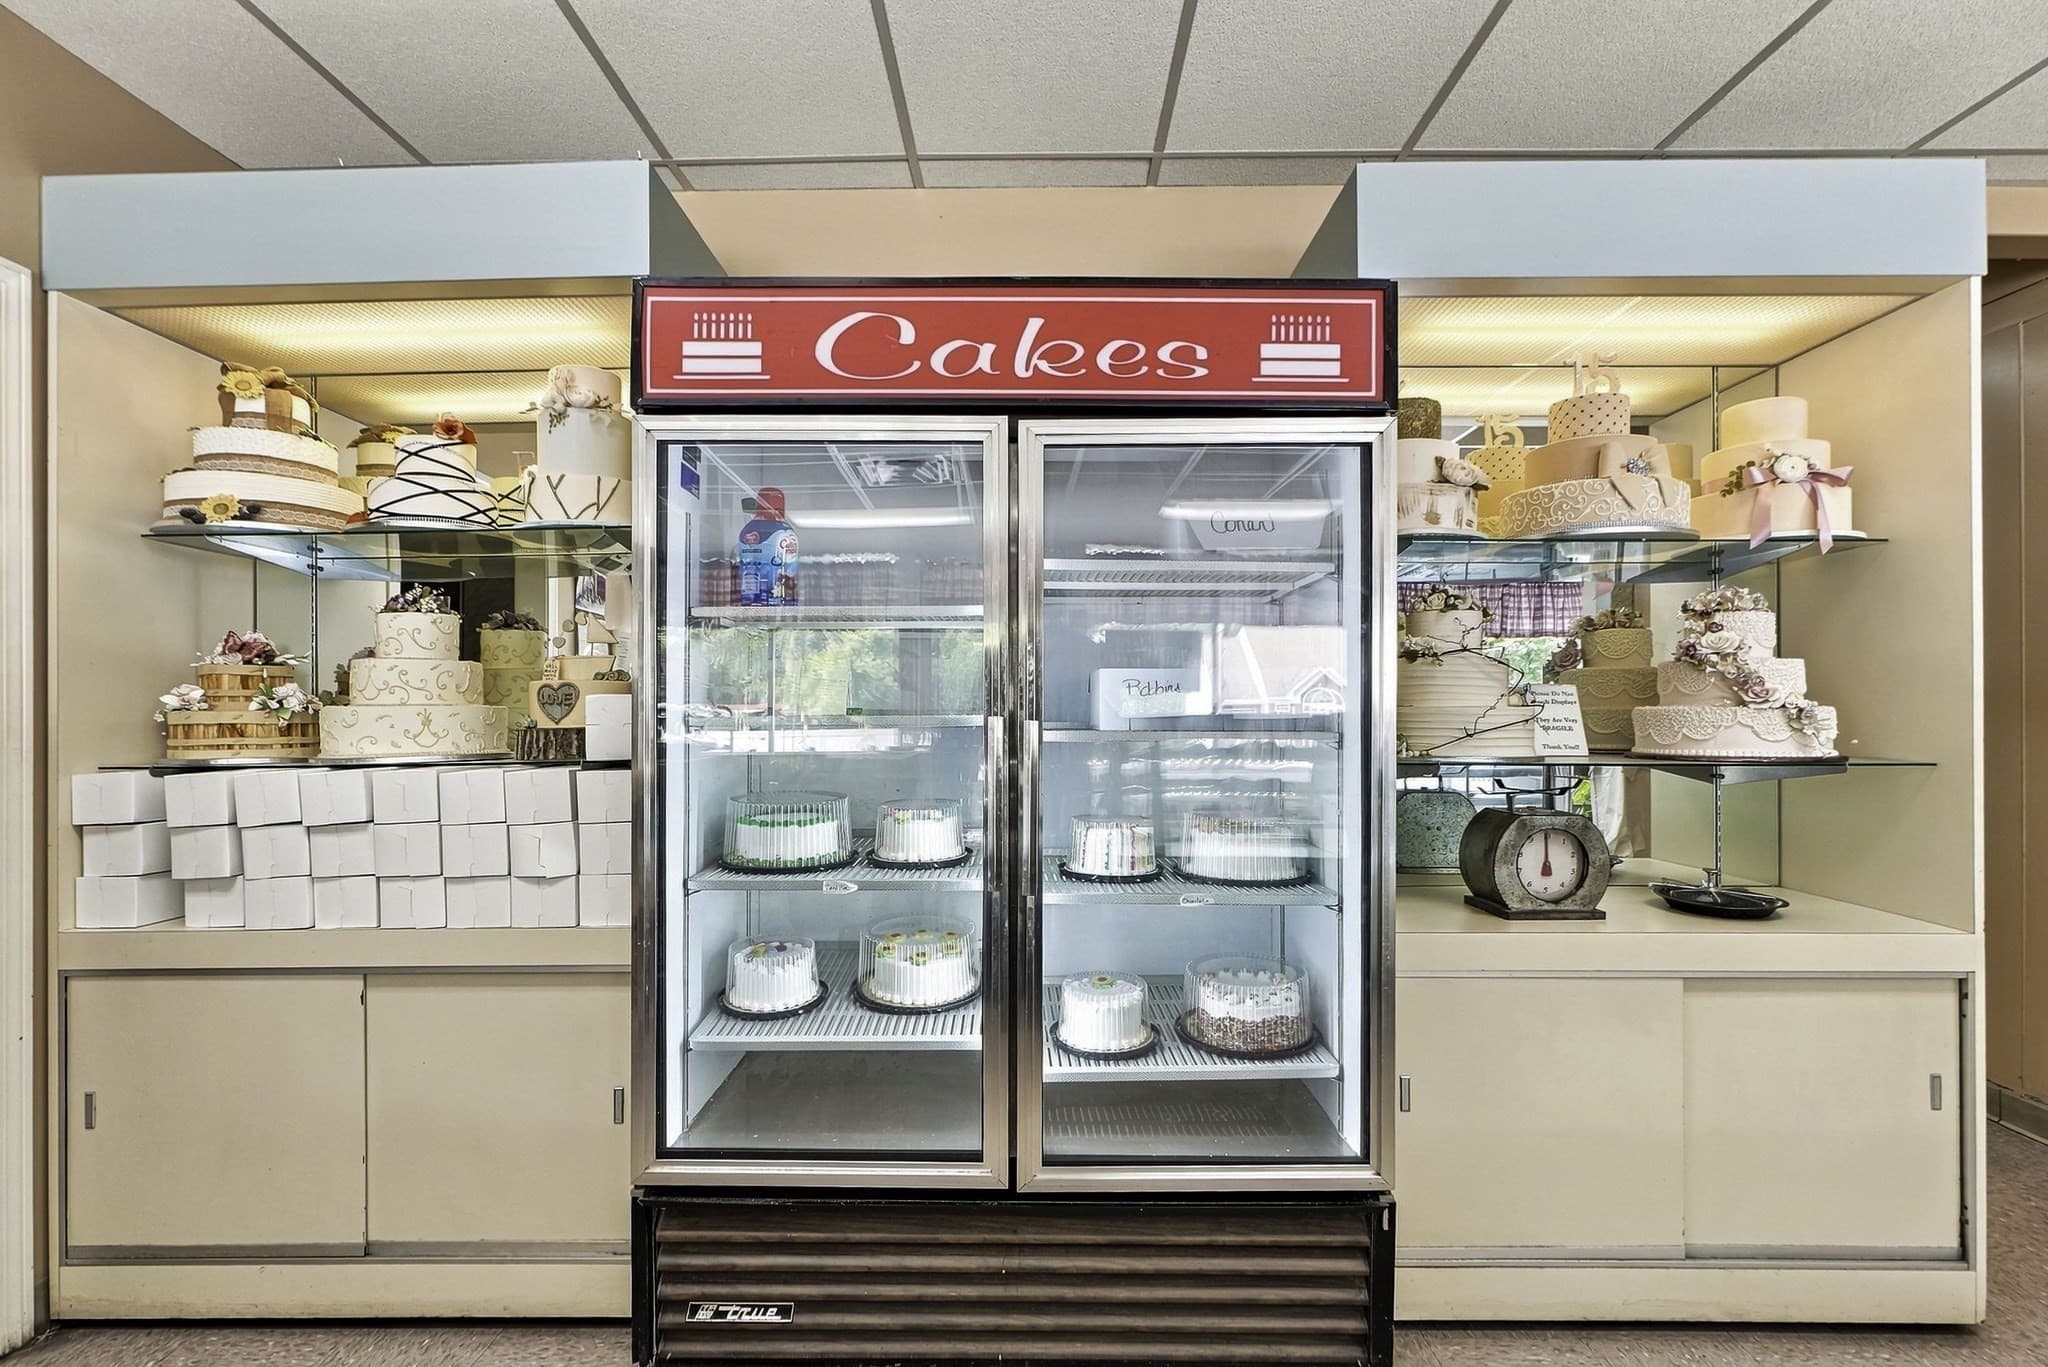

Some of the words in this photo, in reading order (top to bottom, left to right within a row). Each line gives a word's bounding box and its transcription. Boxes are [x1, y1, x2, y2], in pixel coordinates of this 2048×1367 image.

[814, 311, 1209, 380] Cakes
[1564, 351, 1621, 395] 15
[541, 691, 573, 706] LOVE
